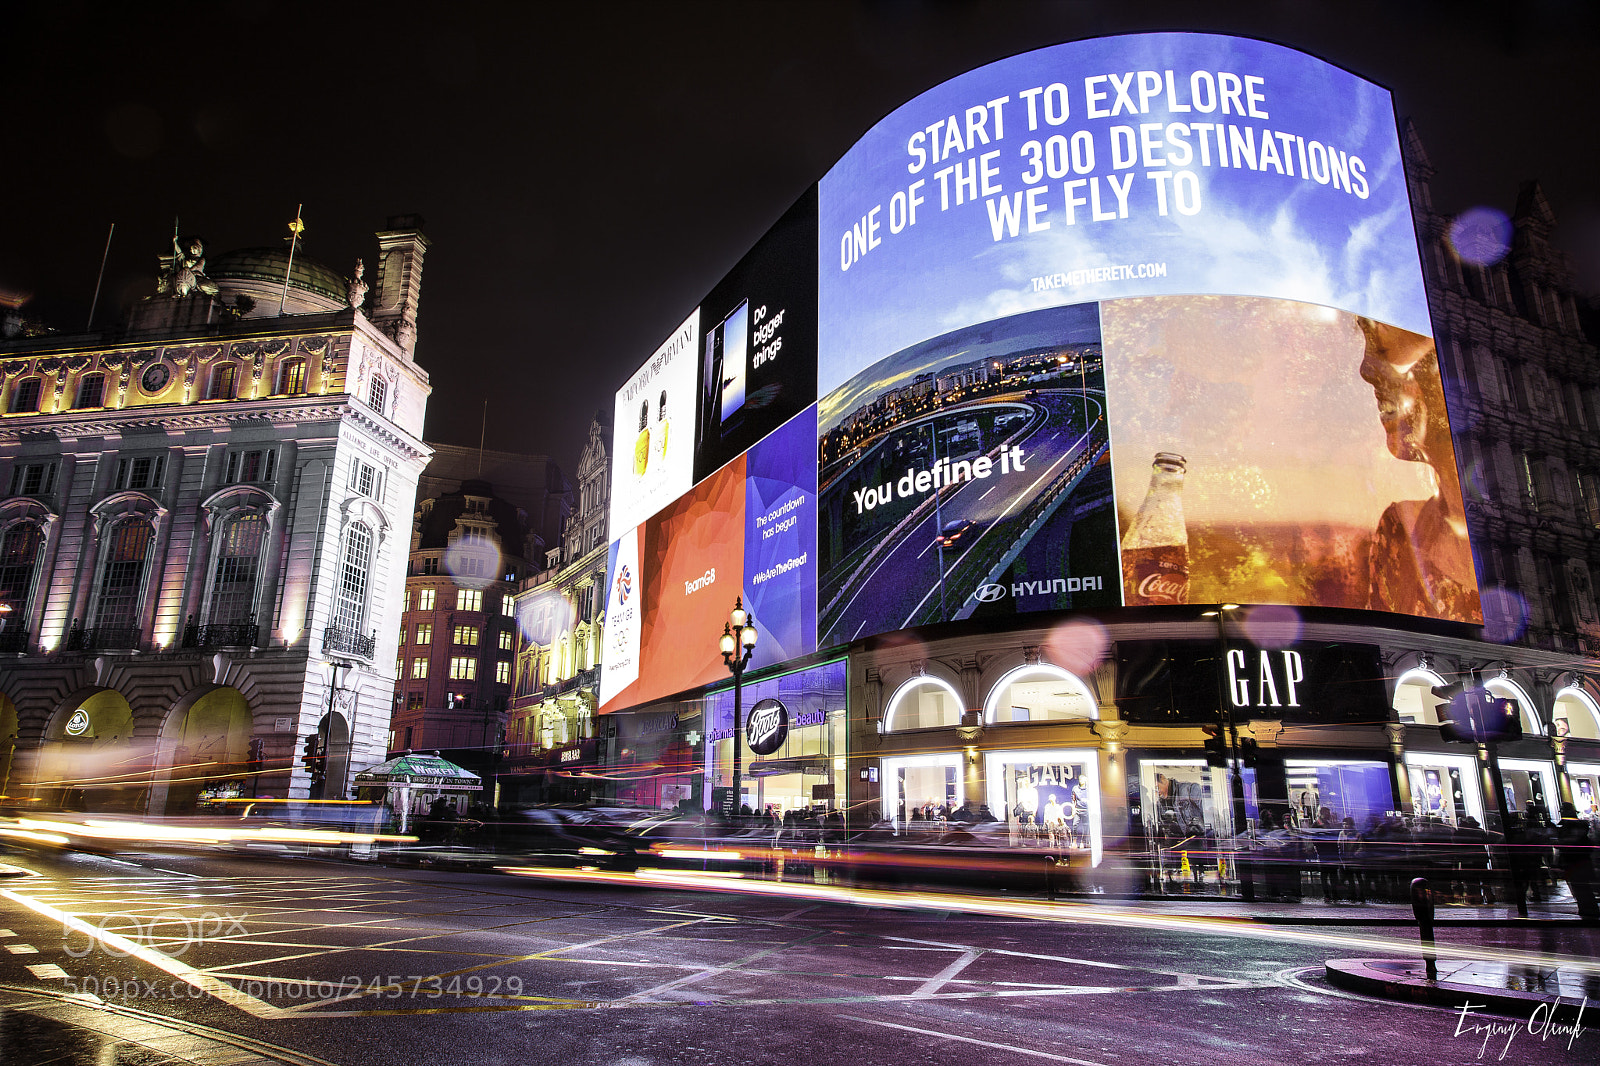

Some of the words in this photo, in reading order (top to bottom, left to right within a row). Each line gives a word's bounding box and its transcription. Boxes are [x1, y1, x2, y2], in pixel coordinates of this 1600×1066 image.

[907, 94, 1010, 174] START
[1019, 82, 1070, 132] TO
[1083, 70, 1269, 120] EXPLORE
[840, 203, 882, 271] ONE
[890, 181, 925, 234] OF
[934, 150, 1003, 212] THE
[1020, 129, 1096, 185] 300
[1109, 122, 1370, 200] DESTINATIONS
[986, 186, 1051, 242] WE
[1061, 172, 1135, 226] FLY
[1146, 169, 1201, 217] TO
[1031, 262, 1167, 292] TAKEMETHERETK.COM
[753, 305, 767, 325] Do
[753, 309, 785, 347] bigger
[753, 336, 782, 369] things
[370, 446, 380, 459] LIFE
[853, 484, 892, 515] You
[896, 455, 993, 498] define
[1000, 444, 1026, 475] it
[756, 515, 768, 528] The
[767, 494, 805, 522] countdown
[762, 526, 774, 541] has
[775, 515, 798, 535] begun
[752, 551, 808, 586] #WeAreTheGreat
[1158, 561, 1178, 570] zero
[1011, 576, 1103, 597] HYUNDAI
[1226, 649, 1304, 707] GAP
[748, 705, 781, 746] Boots
[796, 709, 827, 727] beauty
[1027, 763, 1074, 789] GAP
[393, 786, 469, 816] WICED
